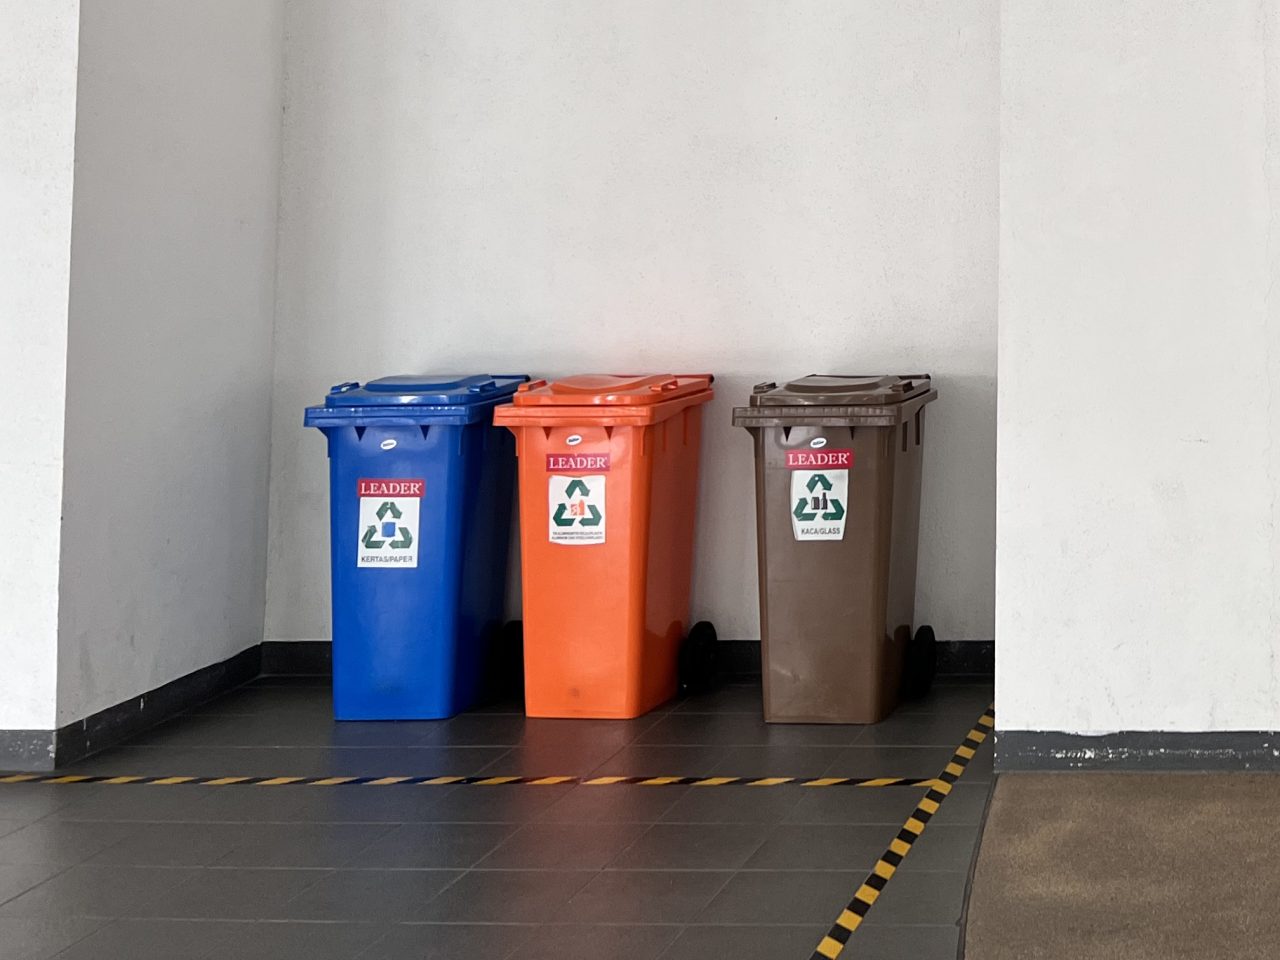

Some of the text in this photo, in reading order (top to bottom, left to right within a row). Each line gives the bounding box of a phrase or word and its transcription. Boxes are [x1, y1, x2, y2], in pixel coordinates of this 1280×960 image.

[549, 456, 606, 469] LEADER
[789, 452, 848, 465] LEADER
[361, 482, 420, 494] LEADER
[801, 527, 841, 535] KACA/GLASS
[361, 555, 413, 563] KERTAS/PAPER
